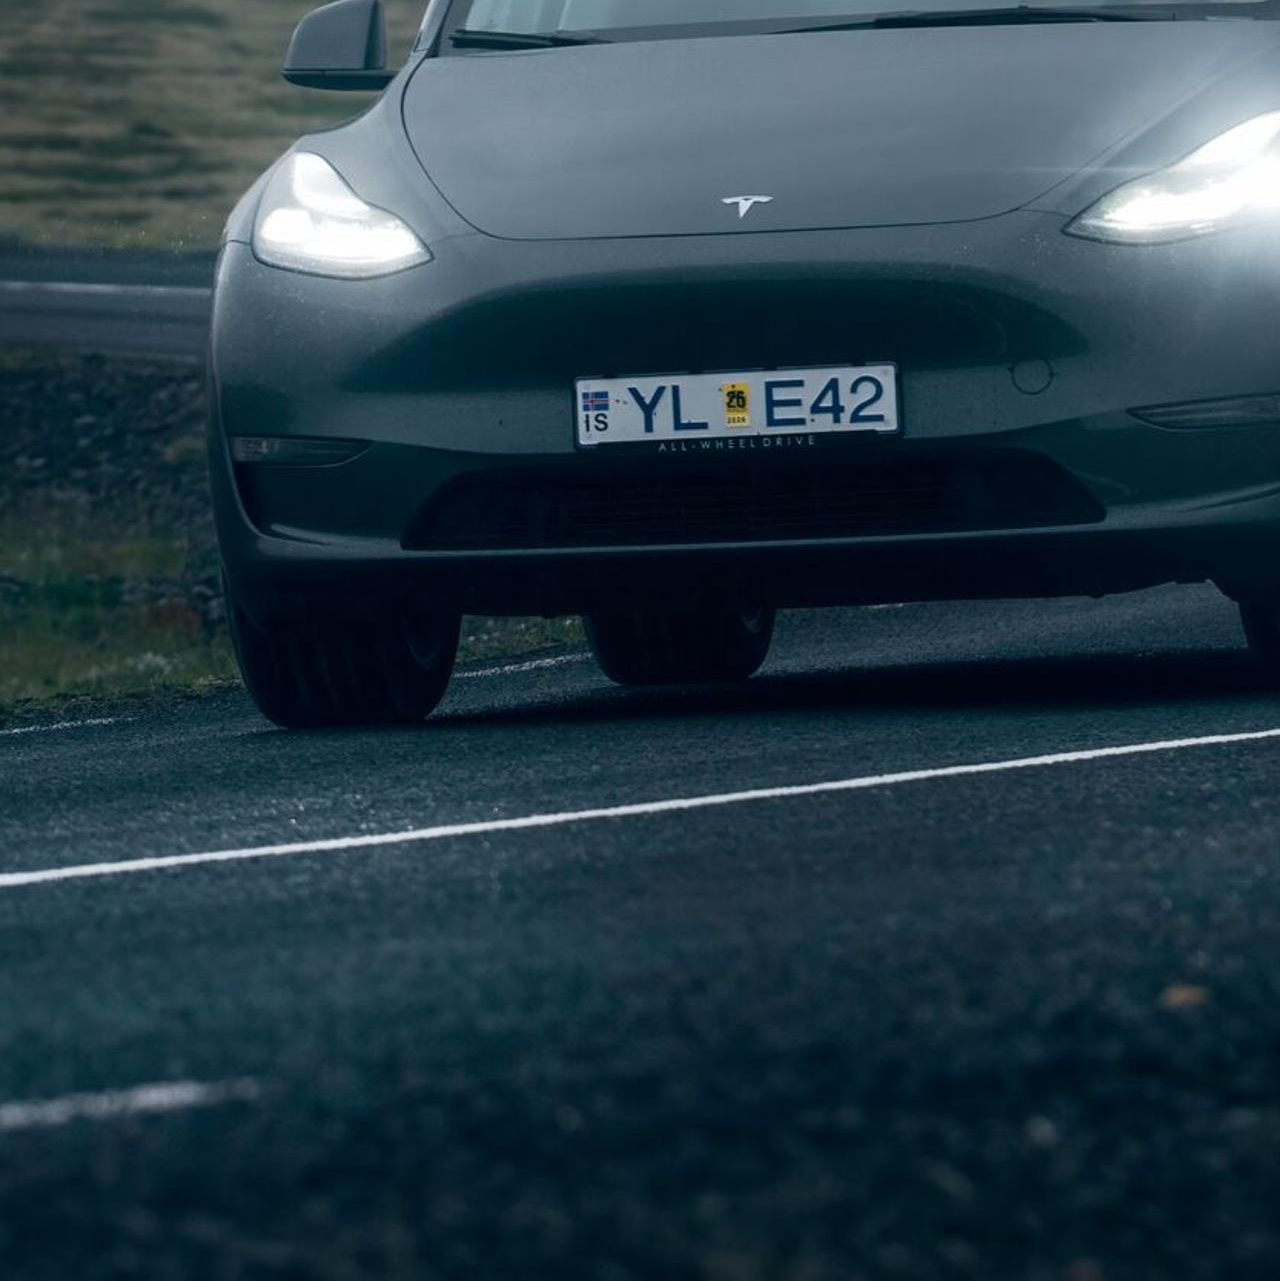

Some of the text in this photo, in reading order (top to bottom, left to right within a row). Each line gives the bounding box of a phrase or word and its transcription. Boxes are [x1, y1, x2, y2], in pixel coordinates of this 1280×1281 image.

[584, 413, 609, 432] IS
[628, 375, 885, 433] YL E42
